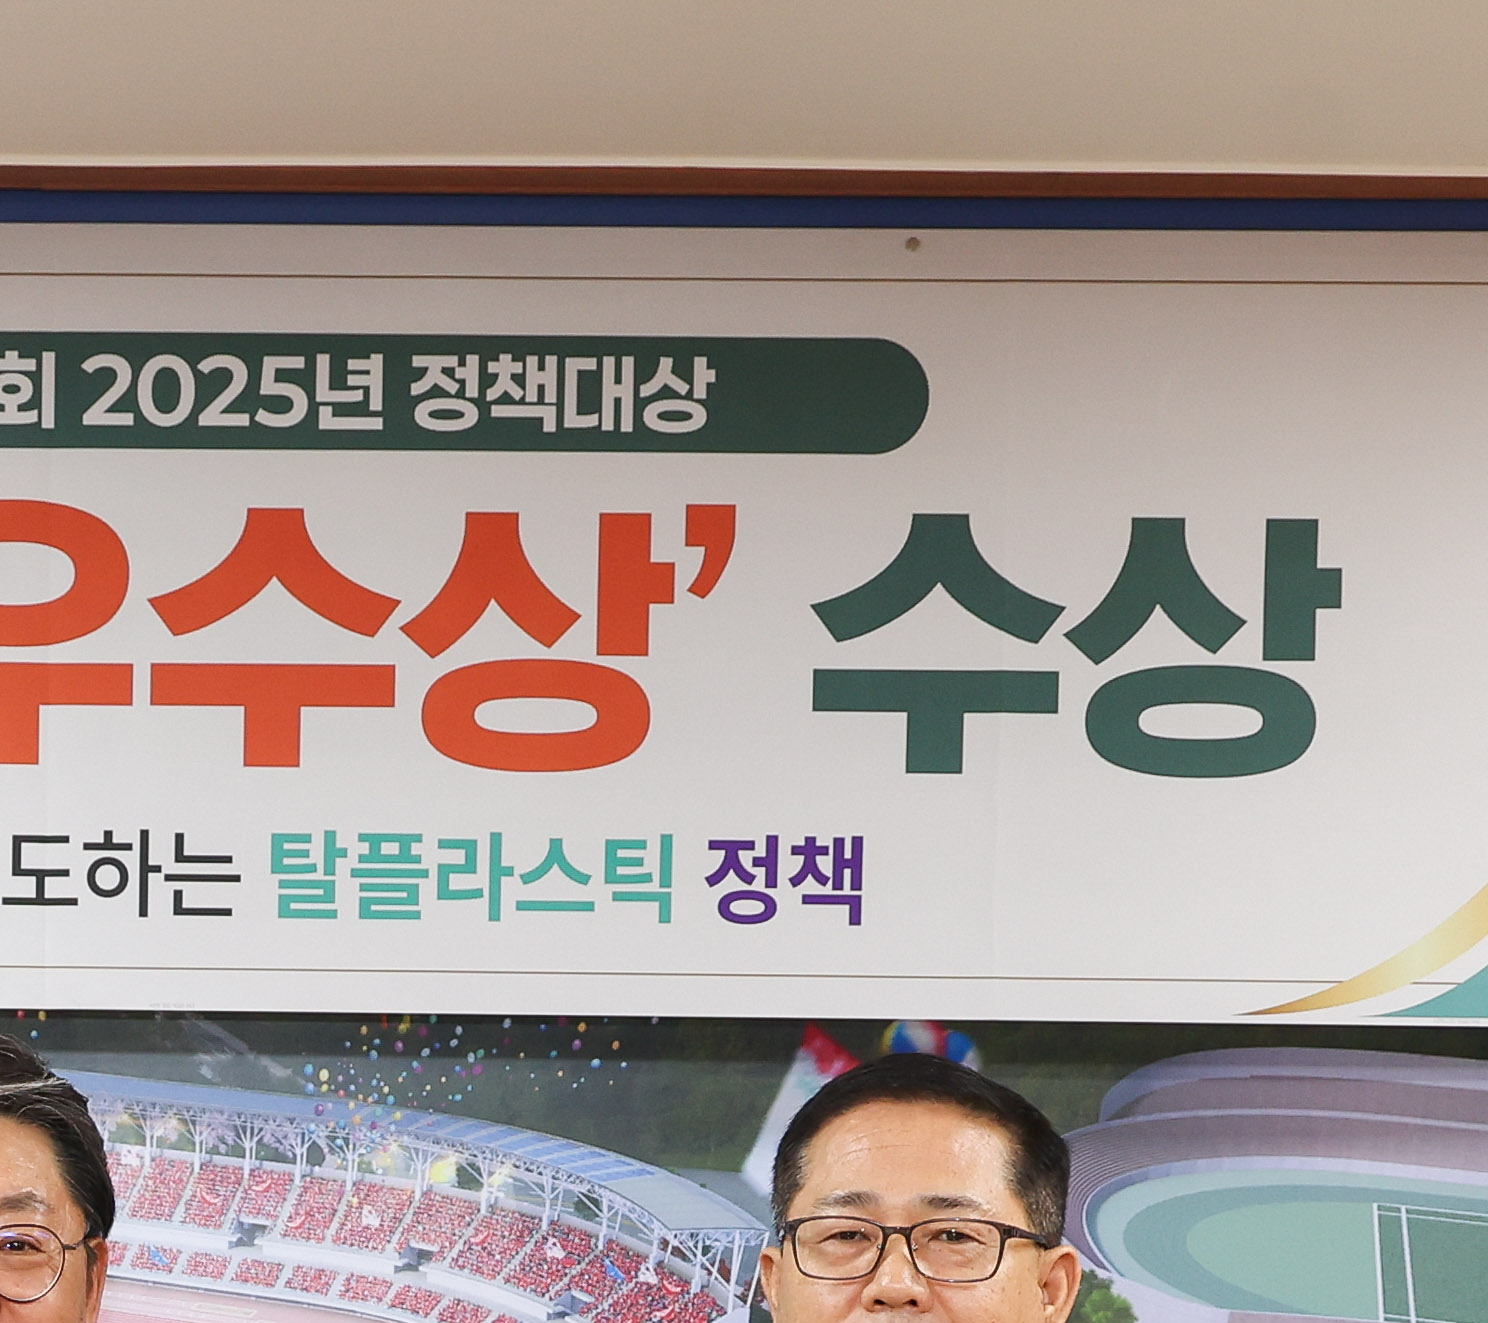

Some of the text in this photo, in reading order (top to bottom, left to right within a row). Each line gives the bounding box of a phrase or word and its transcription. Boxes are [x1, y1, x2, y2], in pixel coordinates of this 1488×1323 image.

[80, 351, 386, 432] 2025년
[410, 353, 717, 434] 정책대상
[810, 512, 1345, 780] 수상
[269, 832, 676, 925] 탈플라스틱
[704, 836, 866, 927] 정책
